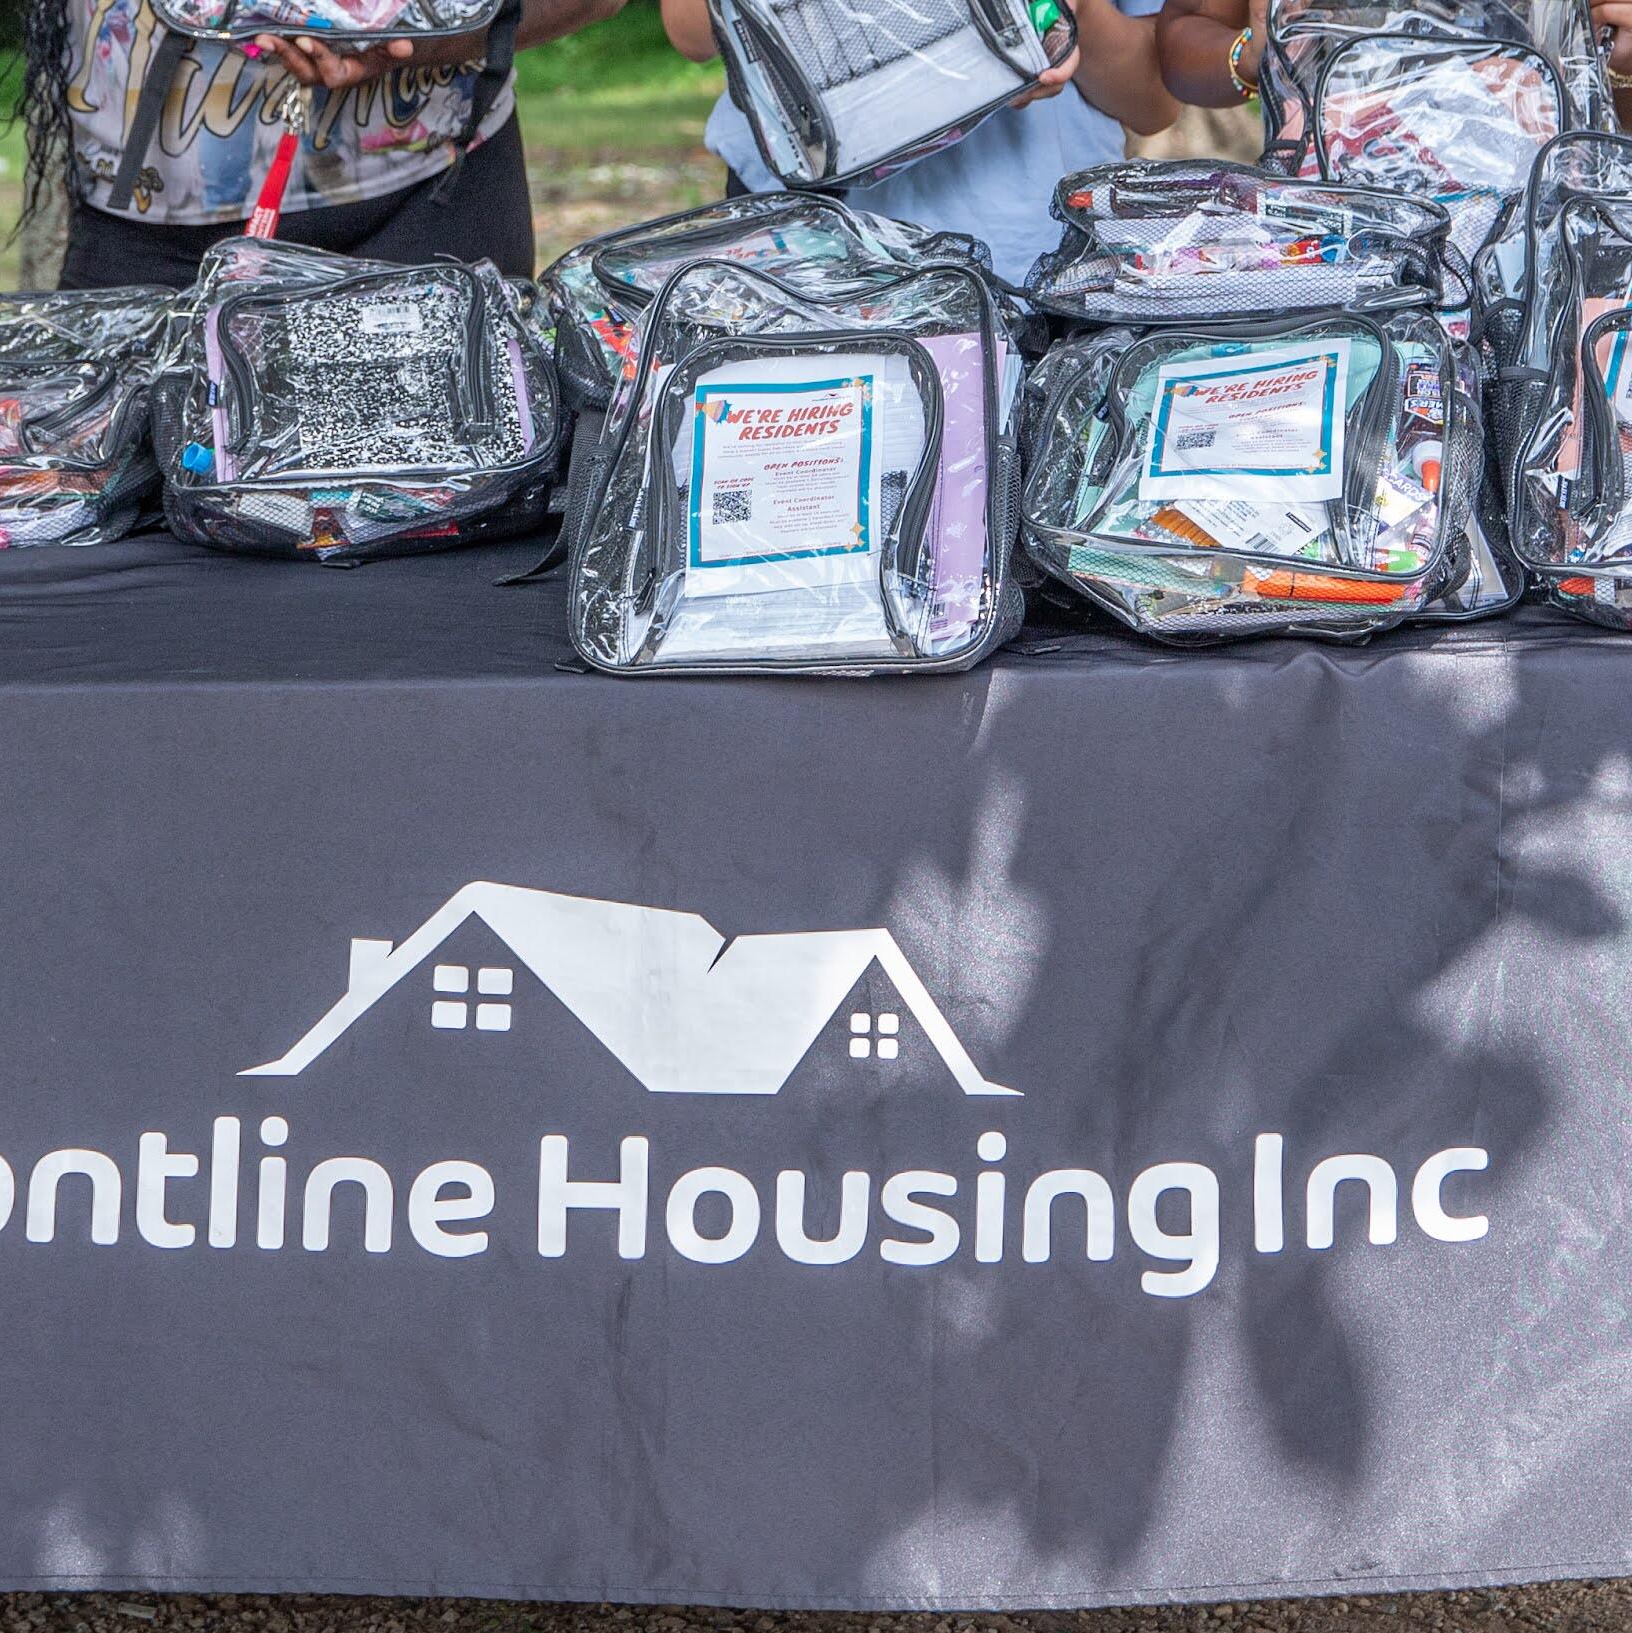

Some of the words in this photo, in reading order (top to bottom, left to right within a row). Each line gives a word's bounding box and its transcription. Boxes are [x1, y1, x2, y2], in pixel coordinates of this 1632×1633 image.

[1194, 382, 1249, 398] WE'RE
[1255, 370, 1319, 388] HIRING
[1205, 382, 1306, 404] RESIDENTS
[726, 408, 783, 424] WE'RE
[787, 402, 854, 423] HIRING
[739, 419, 841, 441] RESIDENTS
[763, 462, 789, 471] OPEN
[787, 504, 821, 512] Assistant
[793, 495, 835, 503] Coordinator
[536, 1131, 1220, 1298] Housing
[1253, 1131, 1490, 1251] Inc
